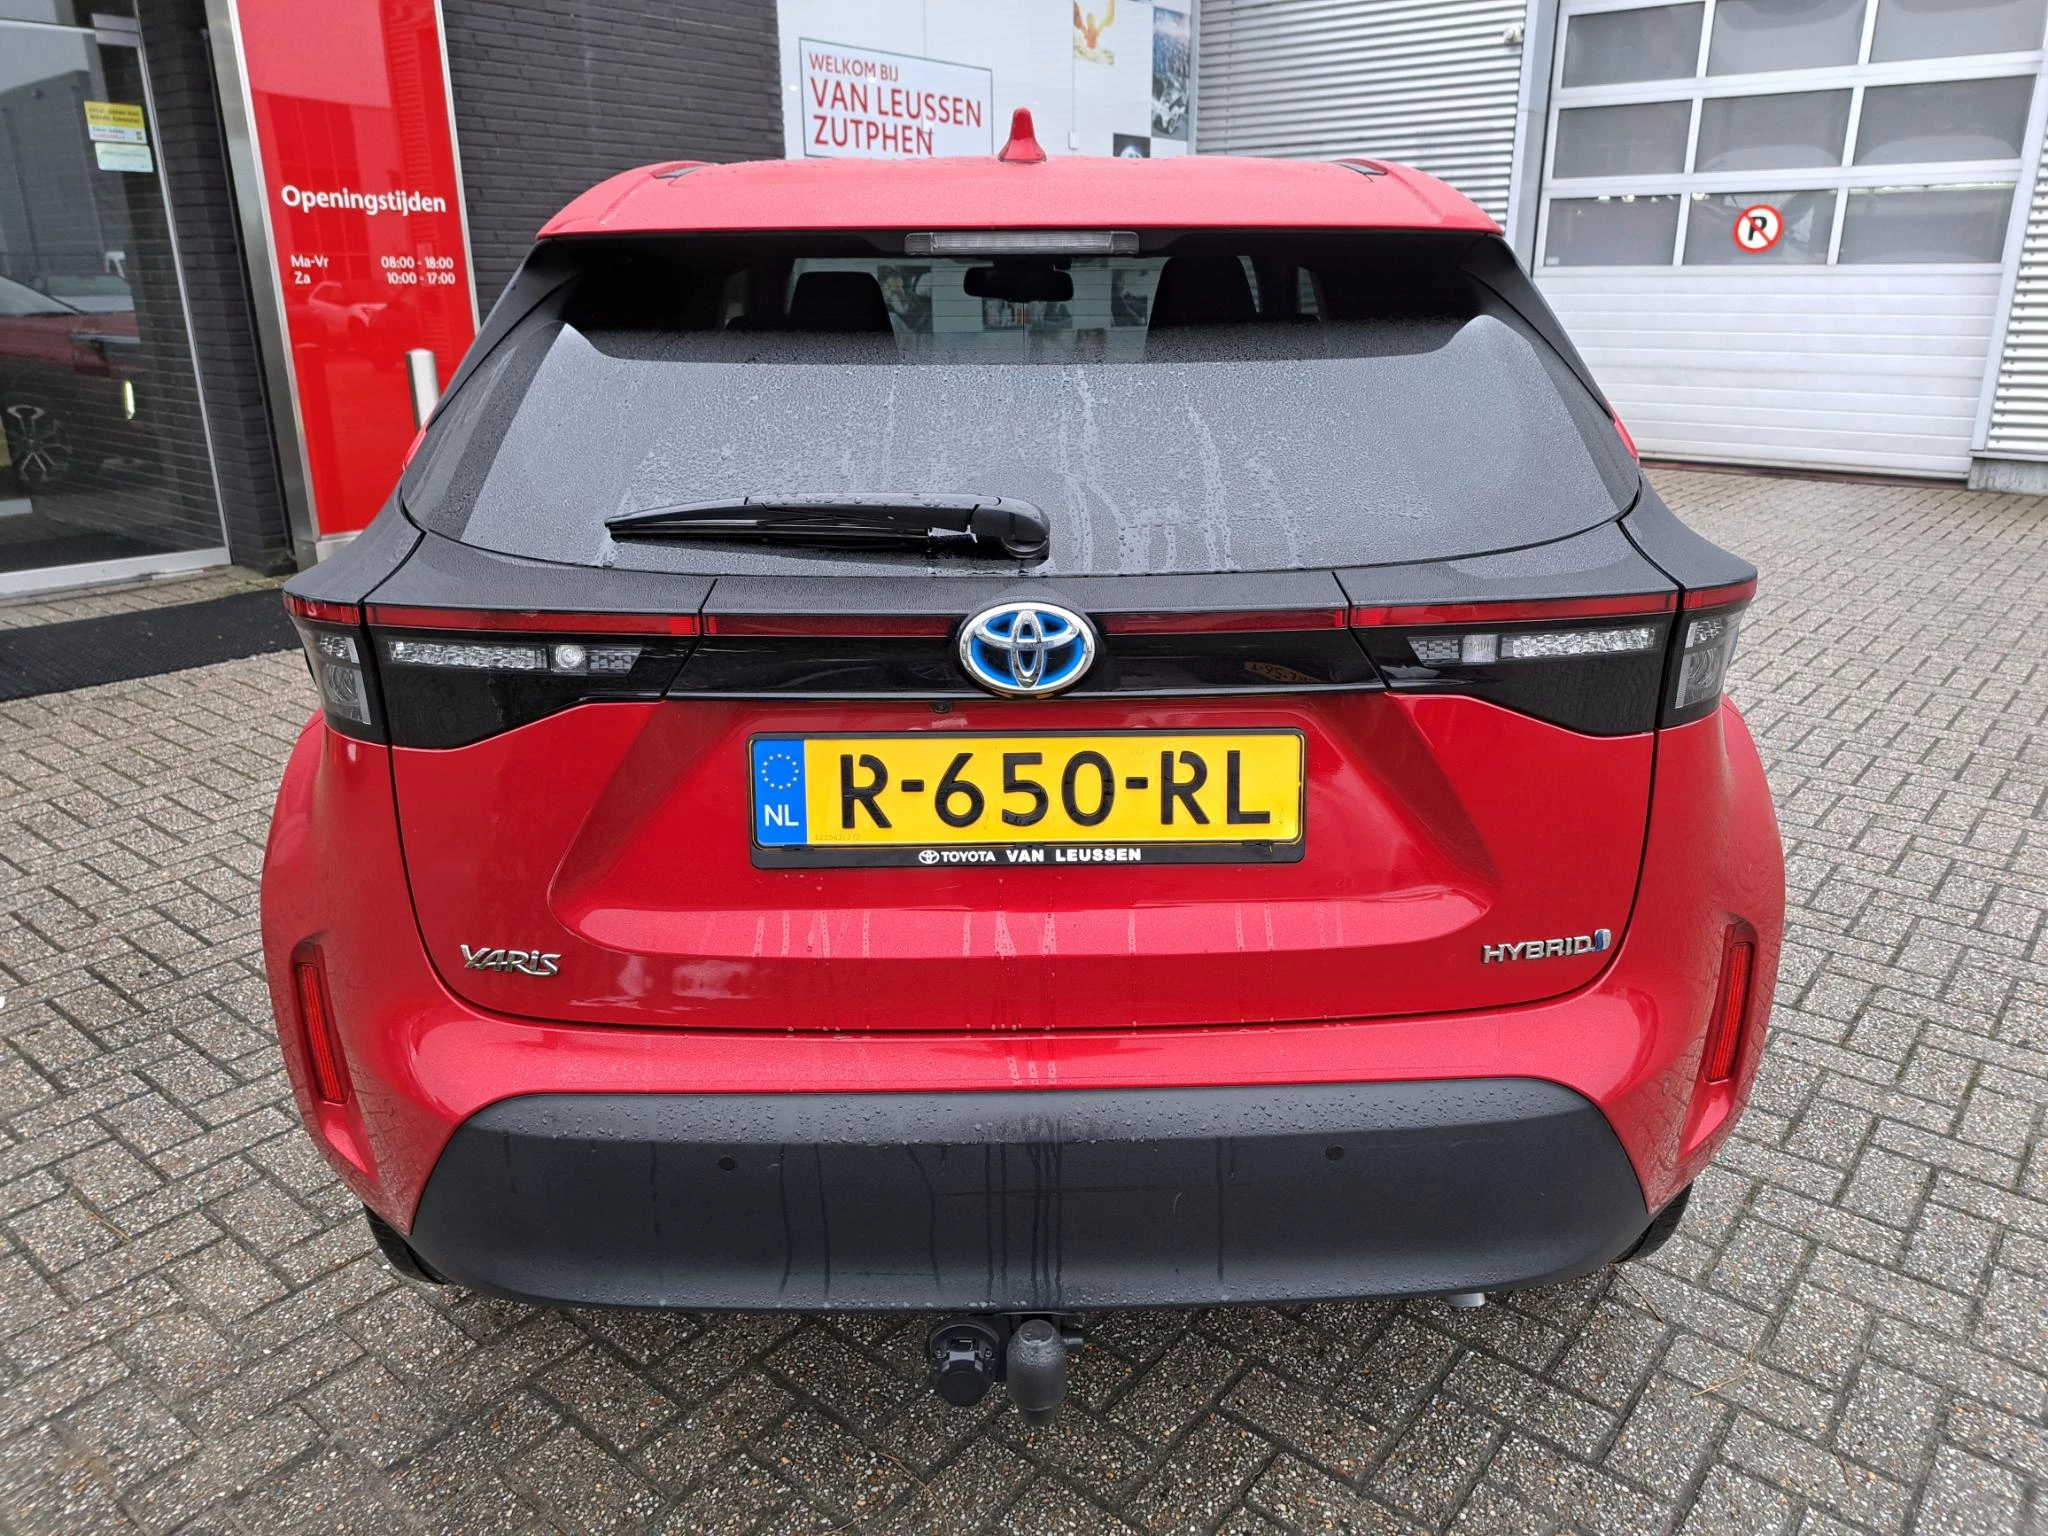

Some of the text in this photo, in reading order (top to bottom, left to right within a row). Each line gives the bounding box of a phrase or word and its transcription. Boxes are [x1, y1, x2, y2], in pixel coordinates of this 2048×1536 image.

[808, 52, 899, 82] WELKOM BIJ
[810, 76, 982, 128] VAN LEUSSEN
[813, 114, 933, 156] ZUTPHEN
[281, 184, 447, 216] Openingstijden
[290, 254, 329, 269] Ma-Vr
[380, 255, 415, 269] 08:00
[424, 256, 454, 269] 18:00
[294, 271, 311, 284] Za
[386, 271, 417, 284] 10:00
[427, 272, 456, 284] 17:00
[839, 749, 1271, 829] R-650-RL
[764, 804, 800, 827] NL
[940, 848, 1142, 863] TOYOTA VAN LEUSSEN
[1482, 935, 1594, 964] HYBRID
